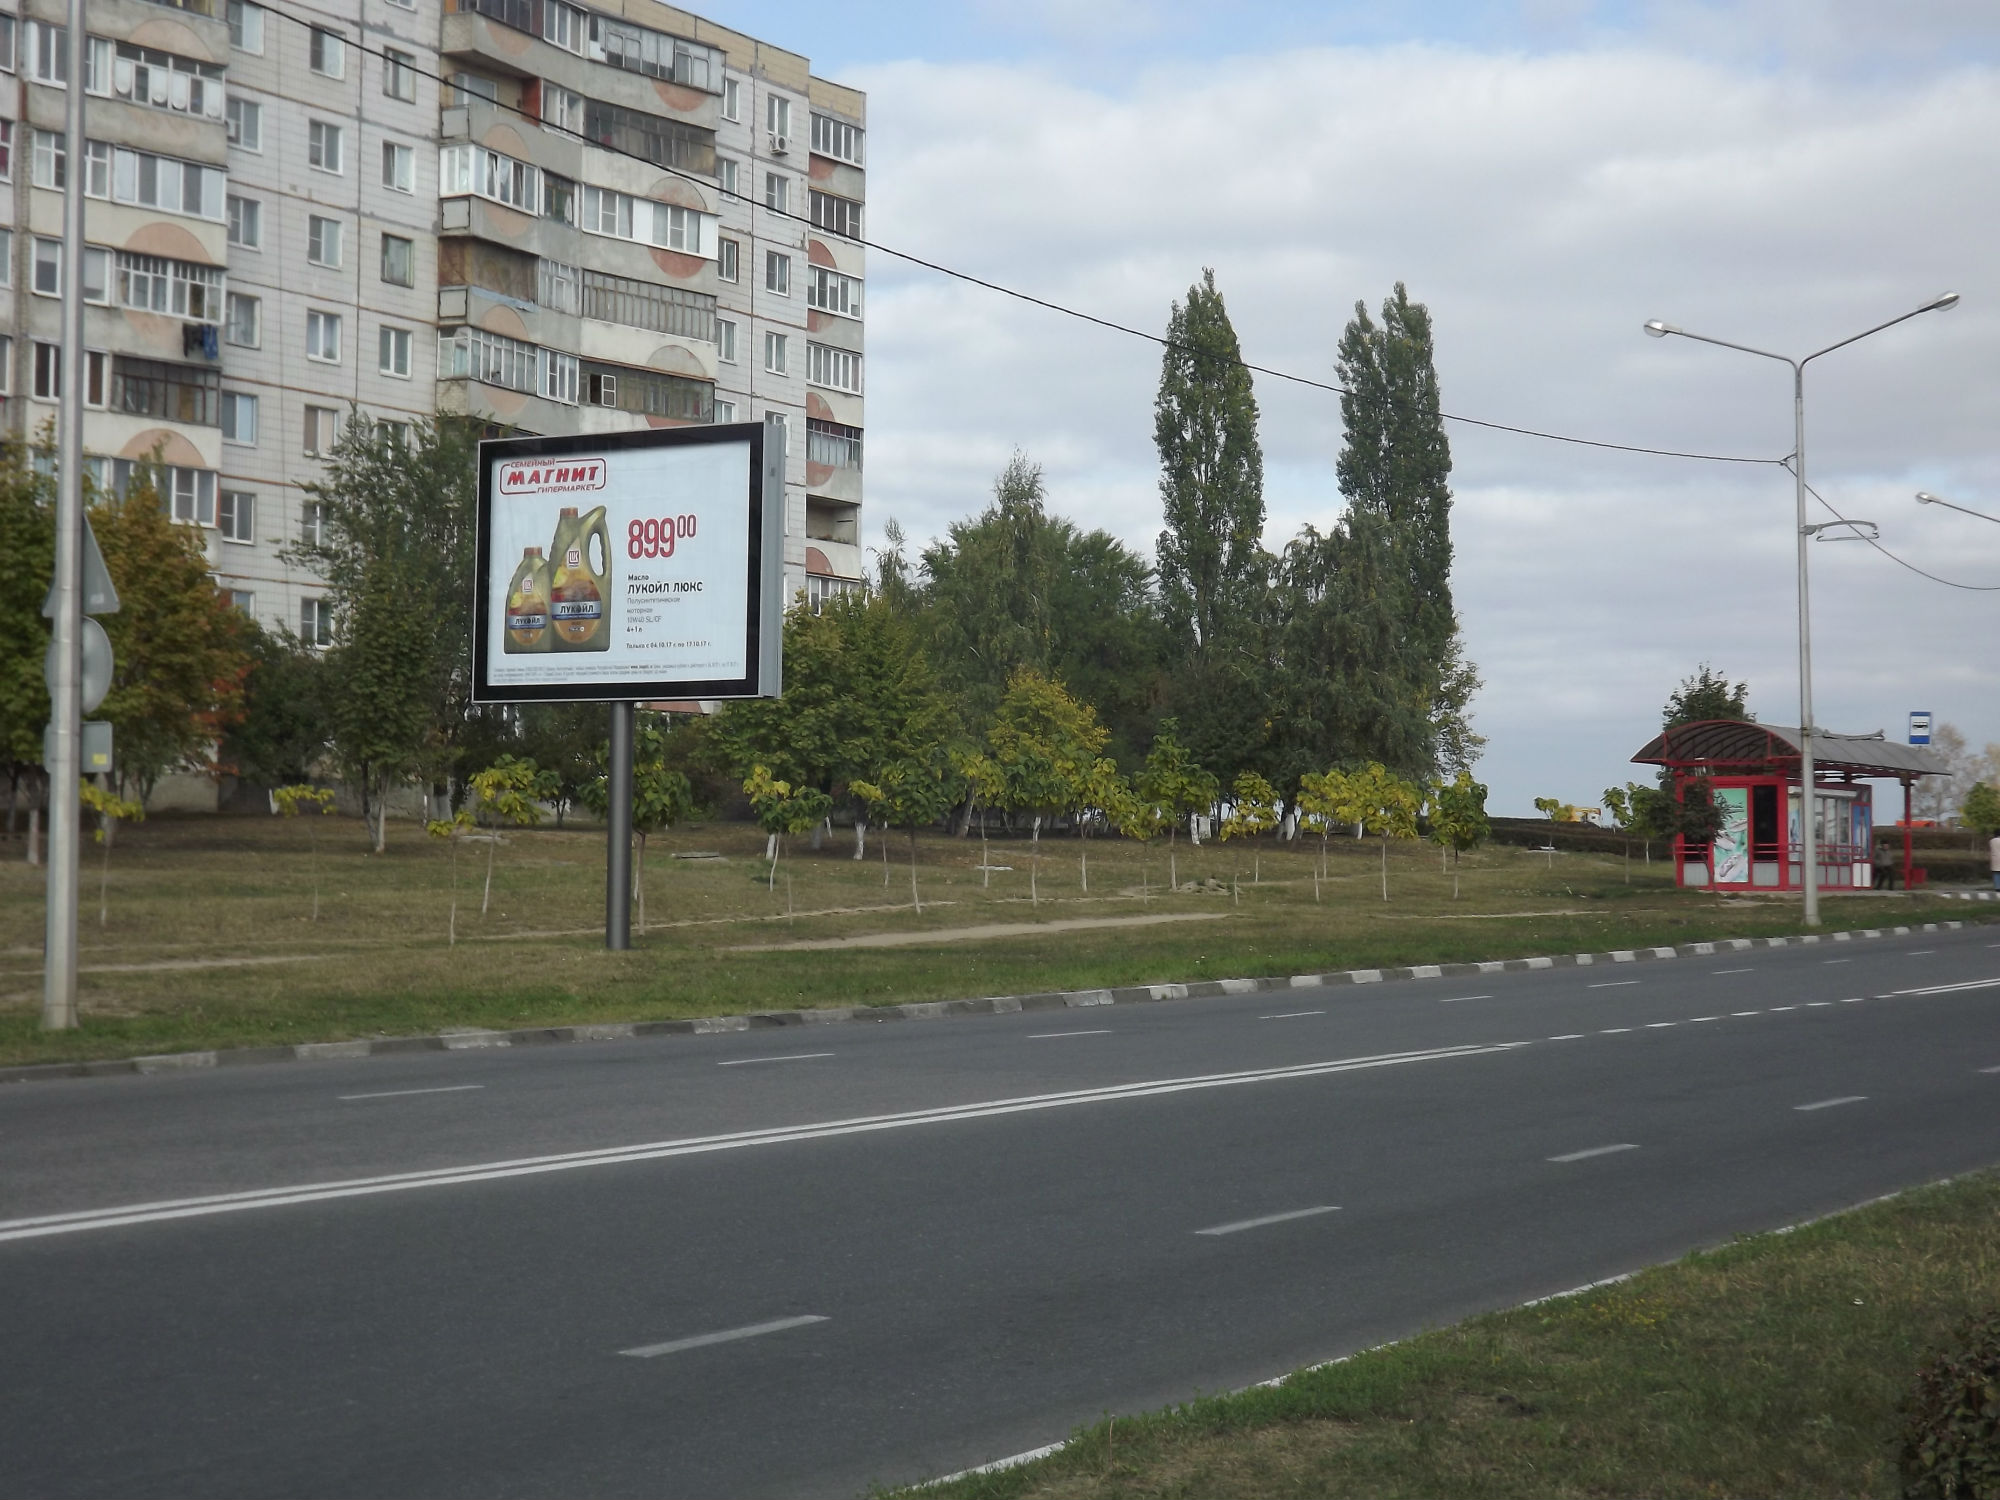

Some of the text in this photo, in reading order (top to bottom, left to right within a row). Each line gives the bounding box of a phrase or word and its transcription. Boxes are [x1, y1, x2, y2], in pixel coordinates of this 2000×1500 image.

[511, 459, 555, 467] СЕМЕЙНЫЙ
[507, 467, 598, 485] МАГНИТ
[537, 484, 596, 493] ГИПЕРМАРКЕТ
[628, 518, 675, 559] 899
[628, 581, 703, 594] ЛУКОЙЛ ЛЮКС
